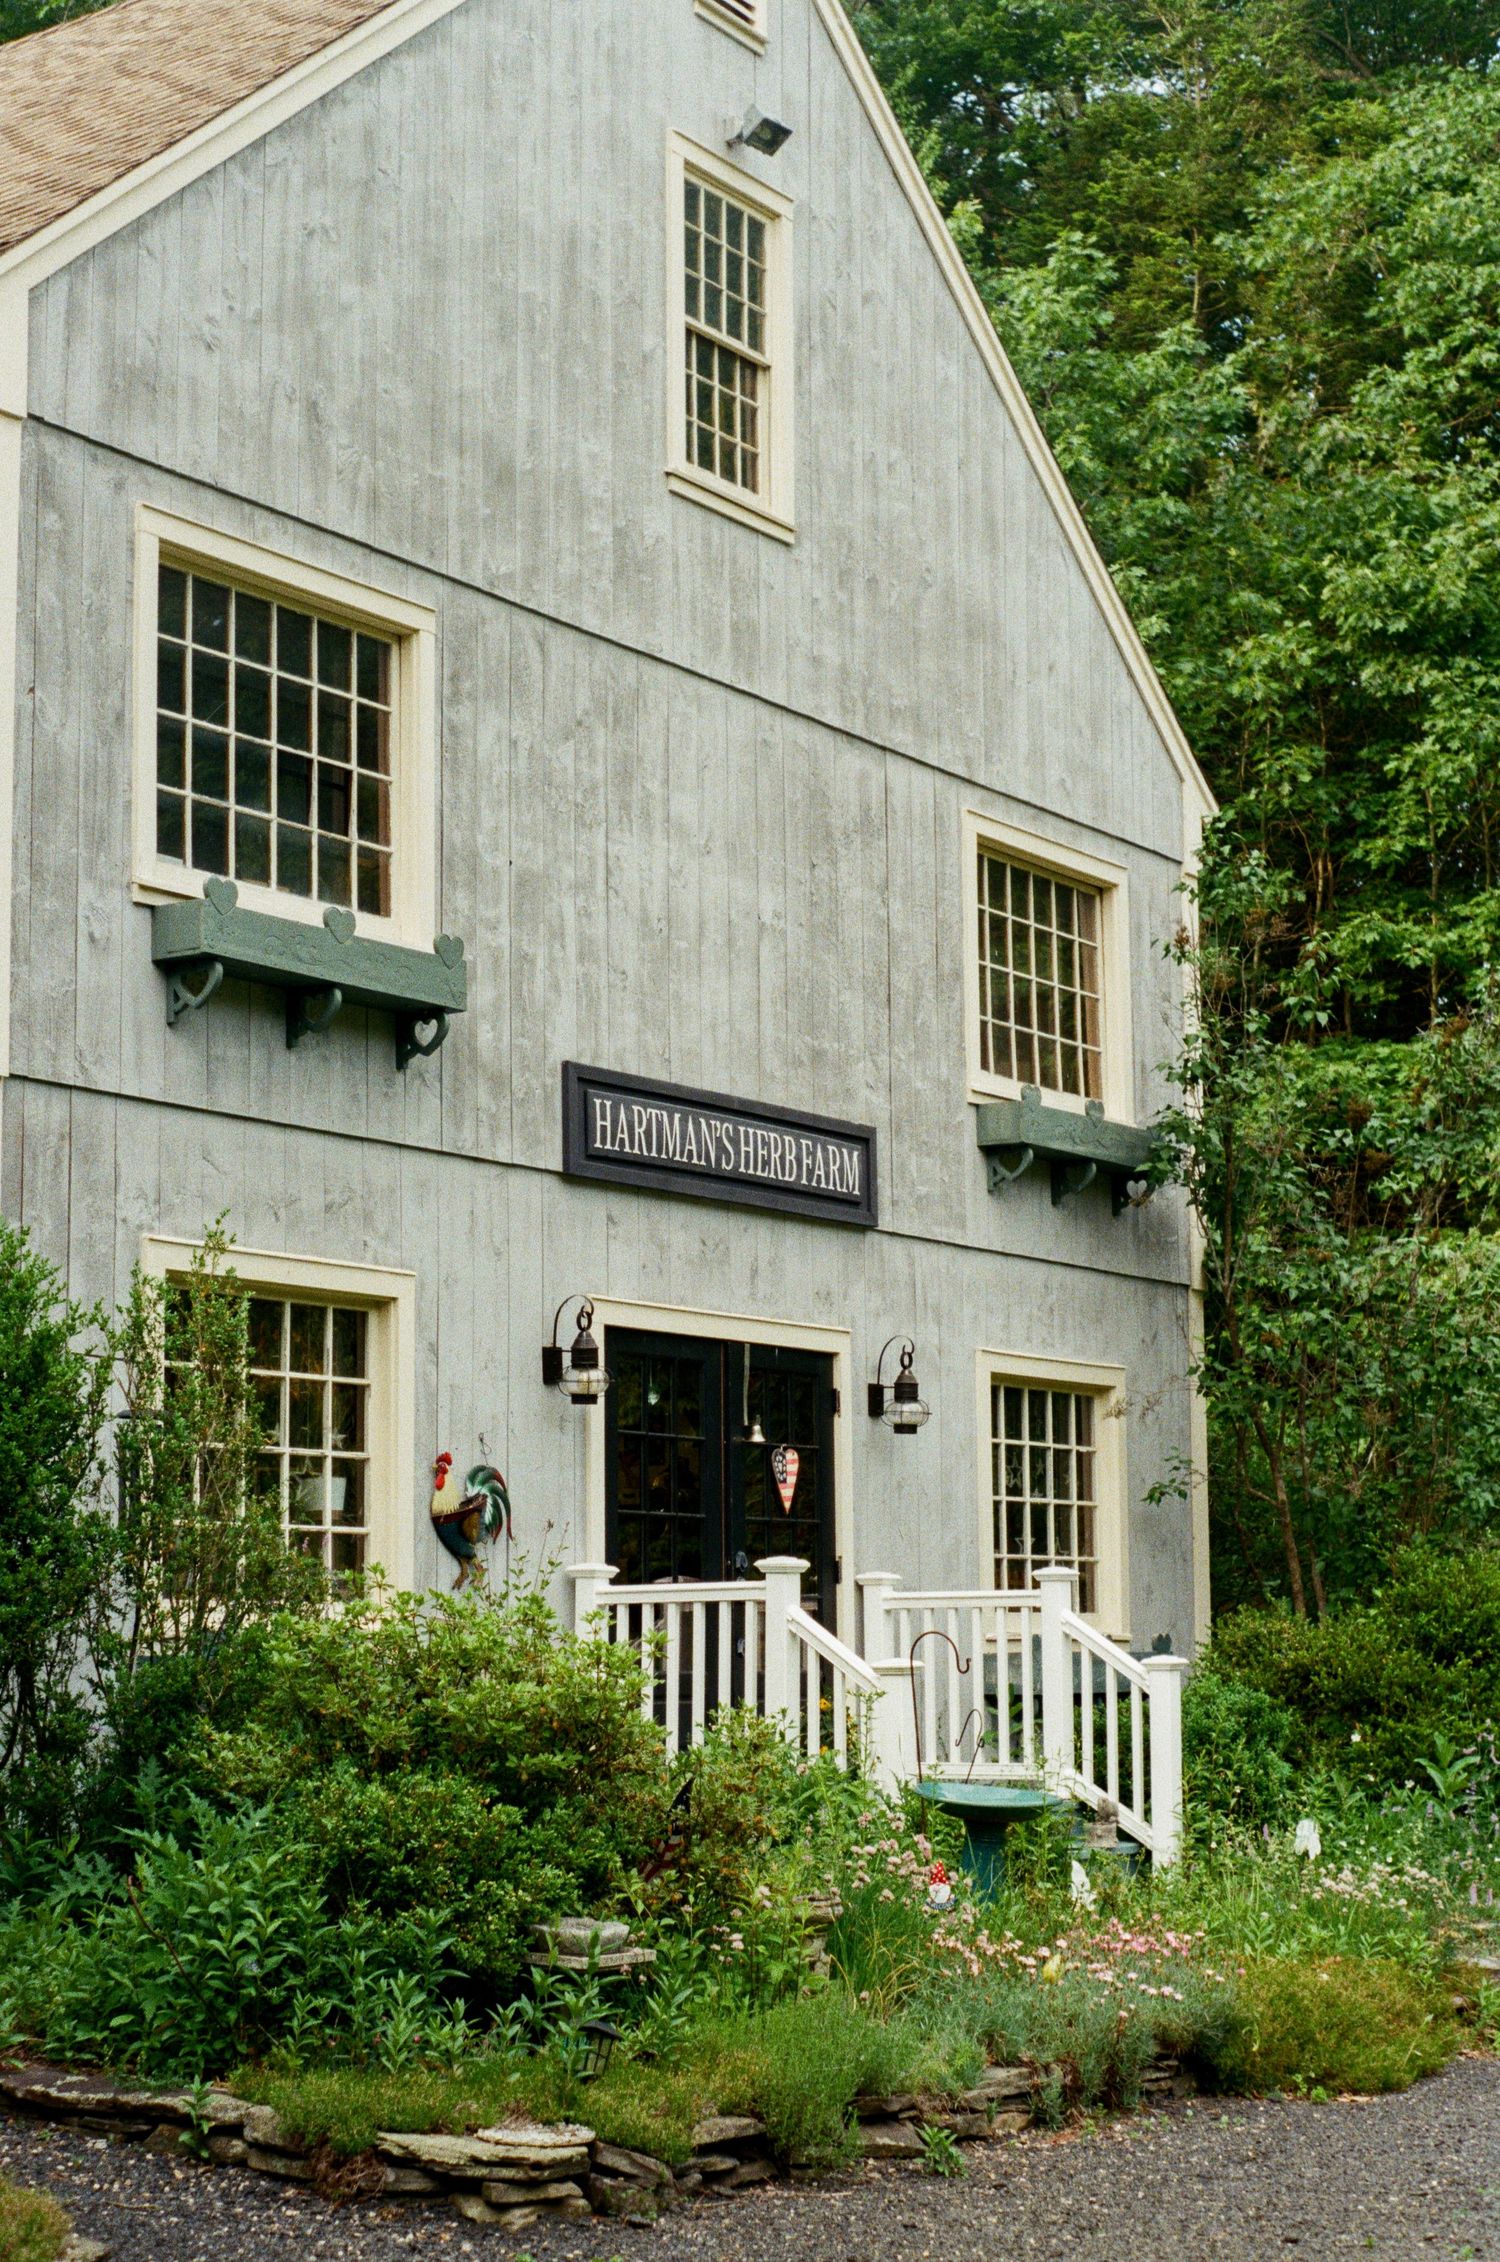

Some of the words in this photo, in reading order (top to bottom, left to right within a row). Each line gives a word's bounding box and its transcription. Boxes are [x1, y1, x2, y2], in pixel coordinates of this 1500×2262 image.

[593, 1097, 735, 1171] HARTMAN'S
[738, 1126, 797, 1182] HERB
[799, 1138, 861, 1196] FARM
